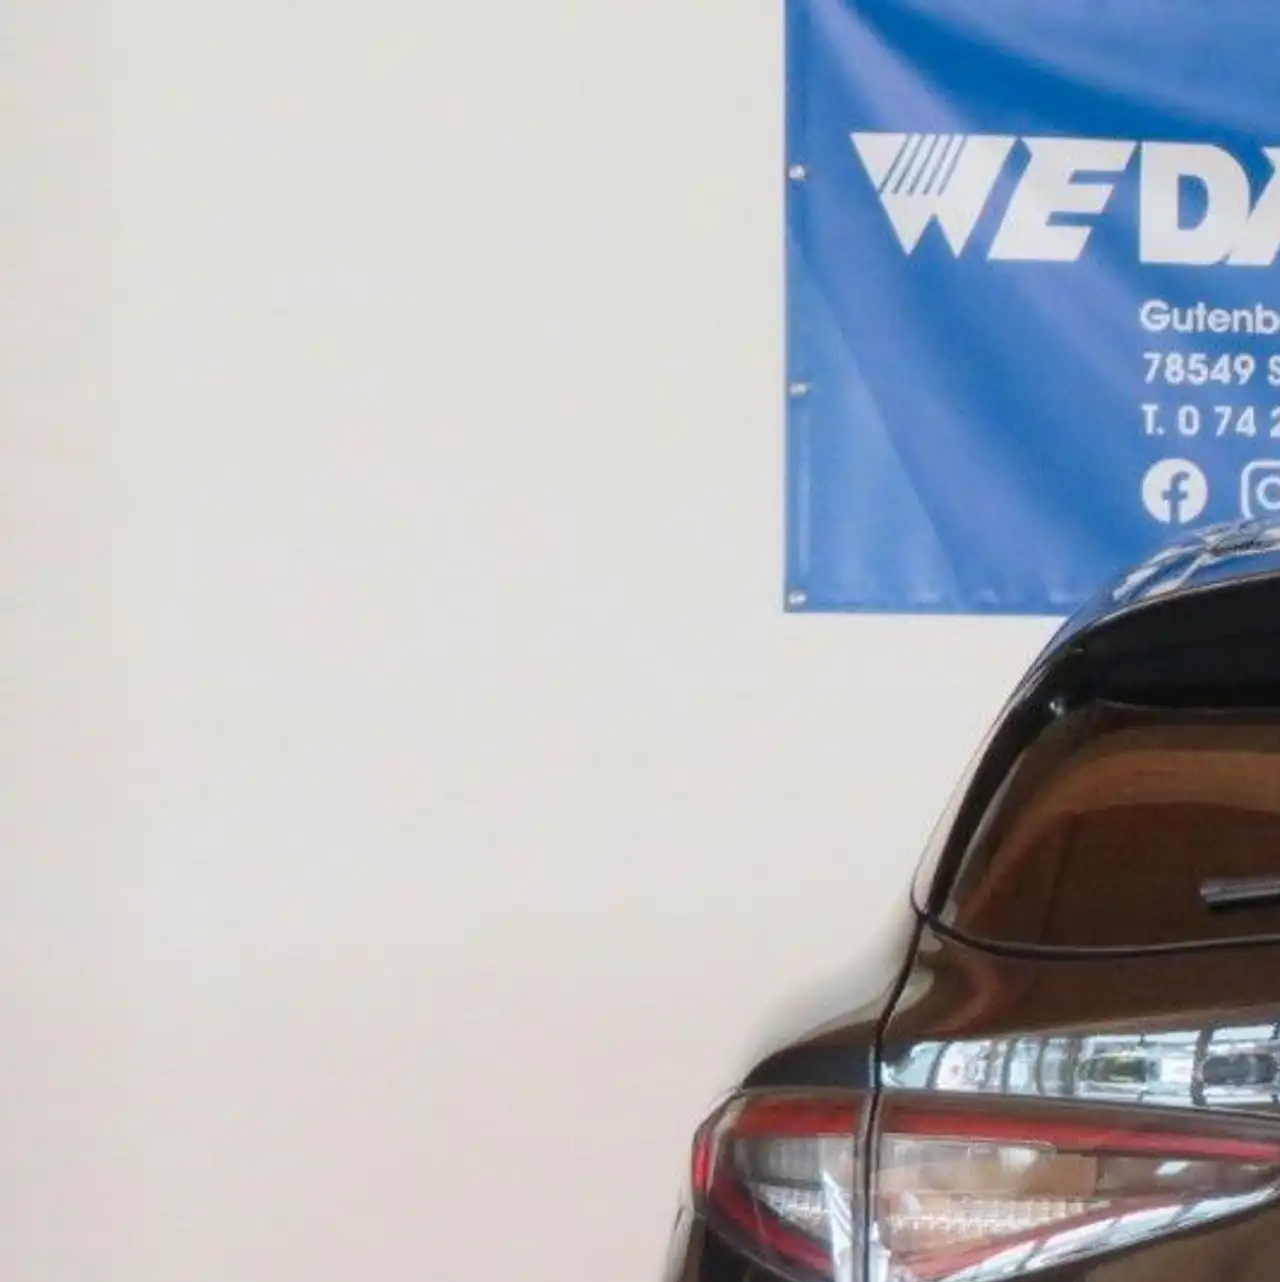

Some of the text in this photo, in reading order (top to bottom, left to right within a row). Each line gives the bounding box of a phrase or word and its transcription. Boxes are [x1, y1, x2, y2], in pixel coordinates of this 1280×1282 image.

[1143, 353, 1256, 385] 78549
[1140, 404, 1165, 436] T.
[1178, 404, 1200, 436] 0
[1213, 405, 1257, 437] 74
